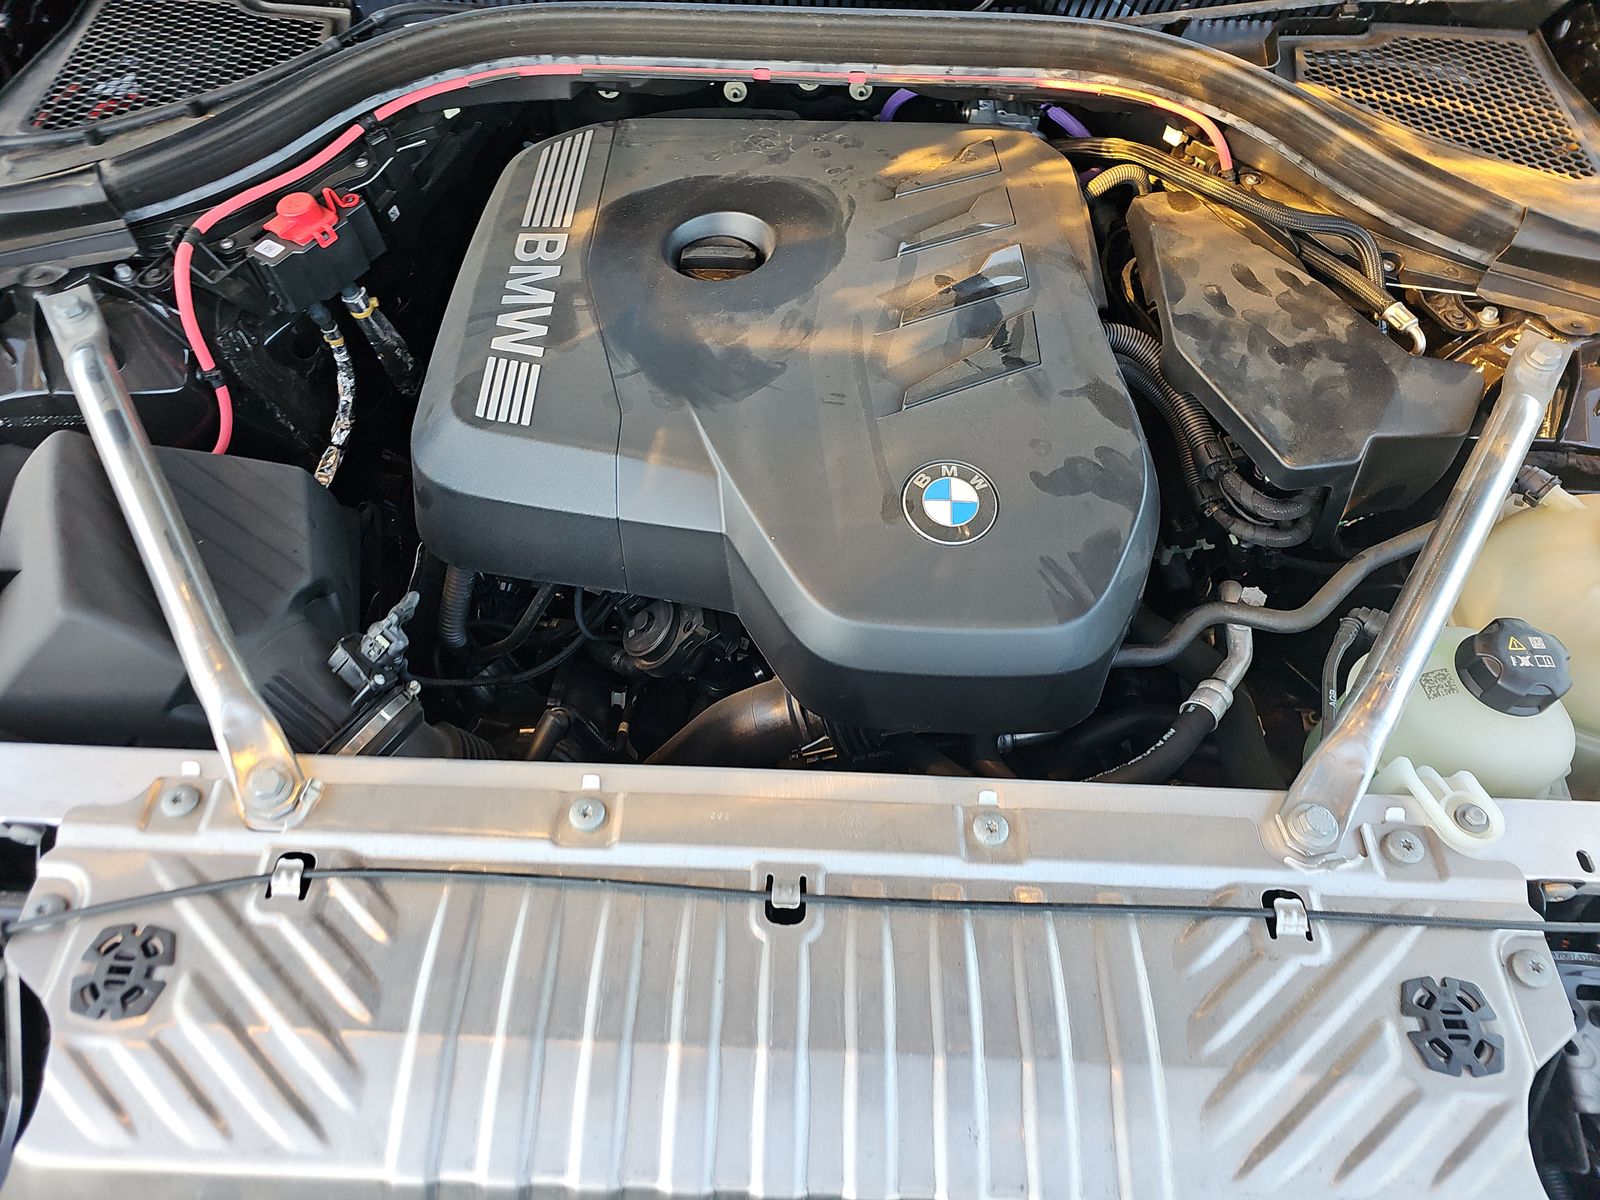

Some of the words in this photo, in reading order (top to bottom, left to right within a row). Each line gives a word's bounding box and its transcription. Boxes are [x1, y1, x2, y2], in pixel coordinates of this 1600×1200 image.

[490, 233, 569, 358] BMW
[913, 465, 989, 491] BMW
[1328, 688, 1337, 709] AGB
